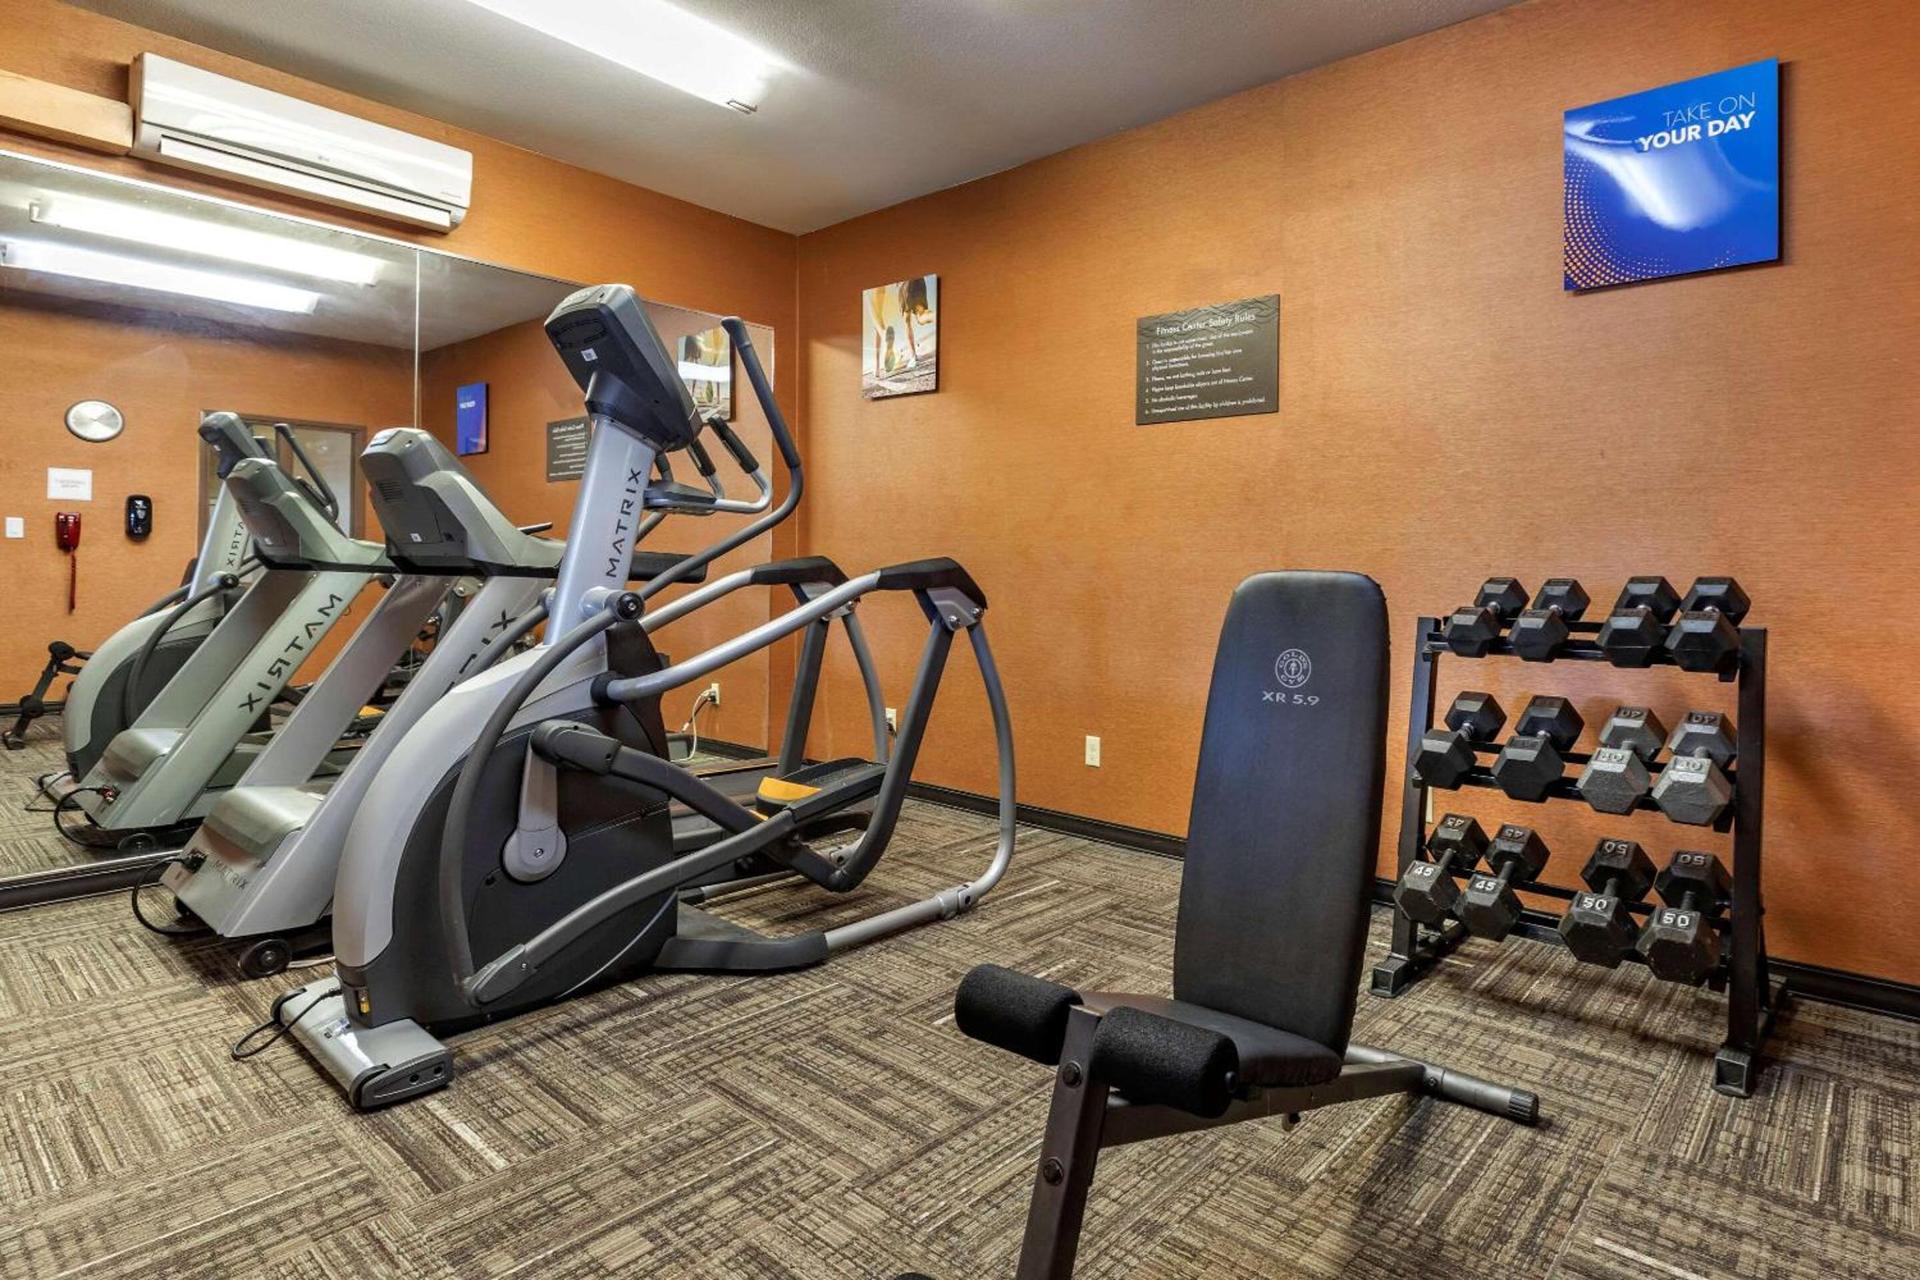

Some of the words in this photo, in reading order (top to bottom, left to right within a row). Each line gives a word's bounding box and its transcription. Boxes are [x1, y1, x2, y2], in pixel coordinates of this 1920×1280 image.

[1662, 101, 1712, 128] TAKE
[1718, 92, 1756, 115] ON
[1639, 124, 1702, 152] YOUR
[1707, 111, 1756, 138] DAY
[605, 467, 642, 578] MATRIX
[1262, 690, 1287, 704] XR
[1292, 693, 1320, 706] 5.9
[1503, 827, 1525, 839] 45
[1603, 841, 1629, 855] 50
[1678, 853, 1706, 866] 50
[1413, 865, 1435, 877] 45
[1474, 879, 1497, 892] 45
[1582, 896, 1608, 911] 50
[1662, 911, 1690, 928] 50
